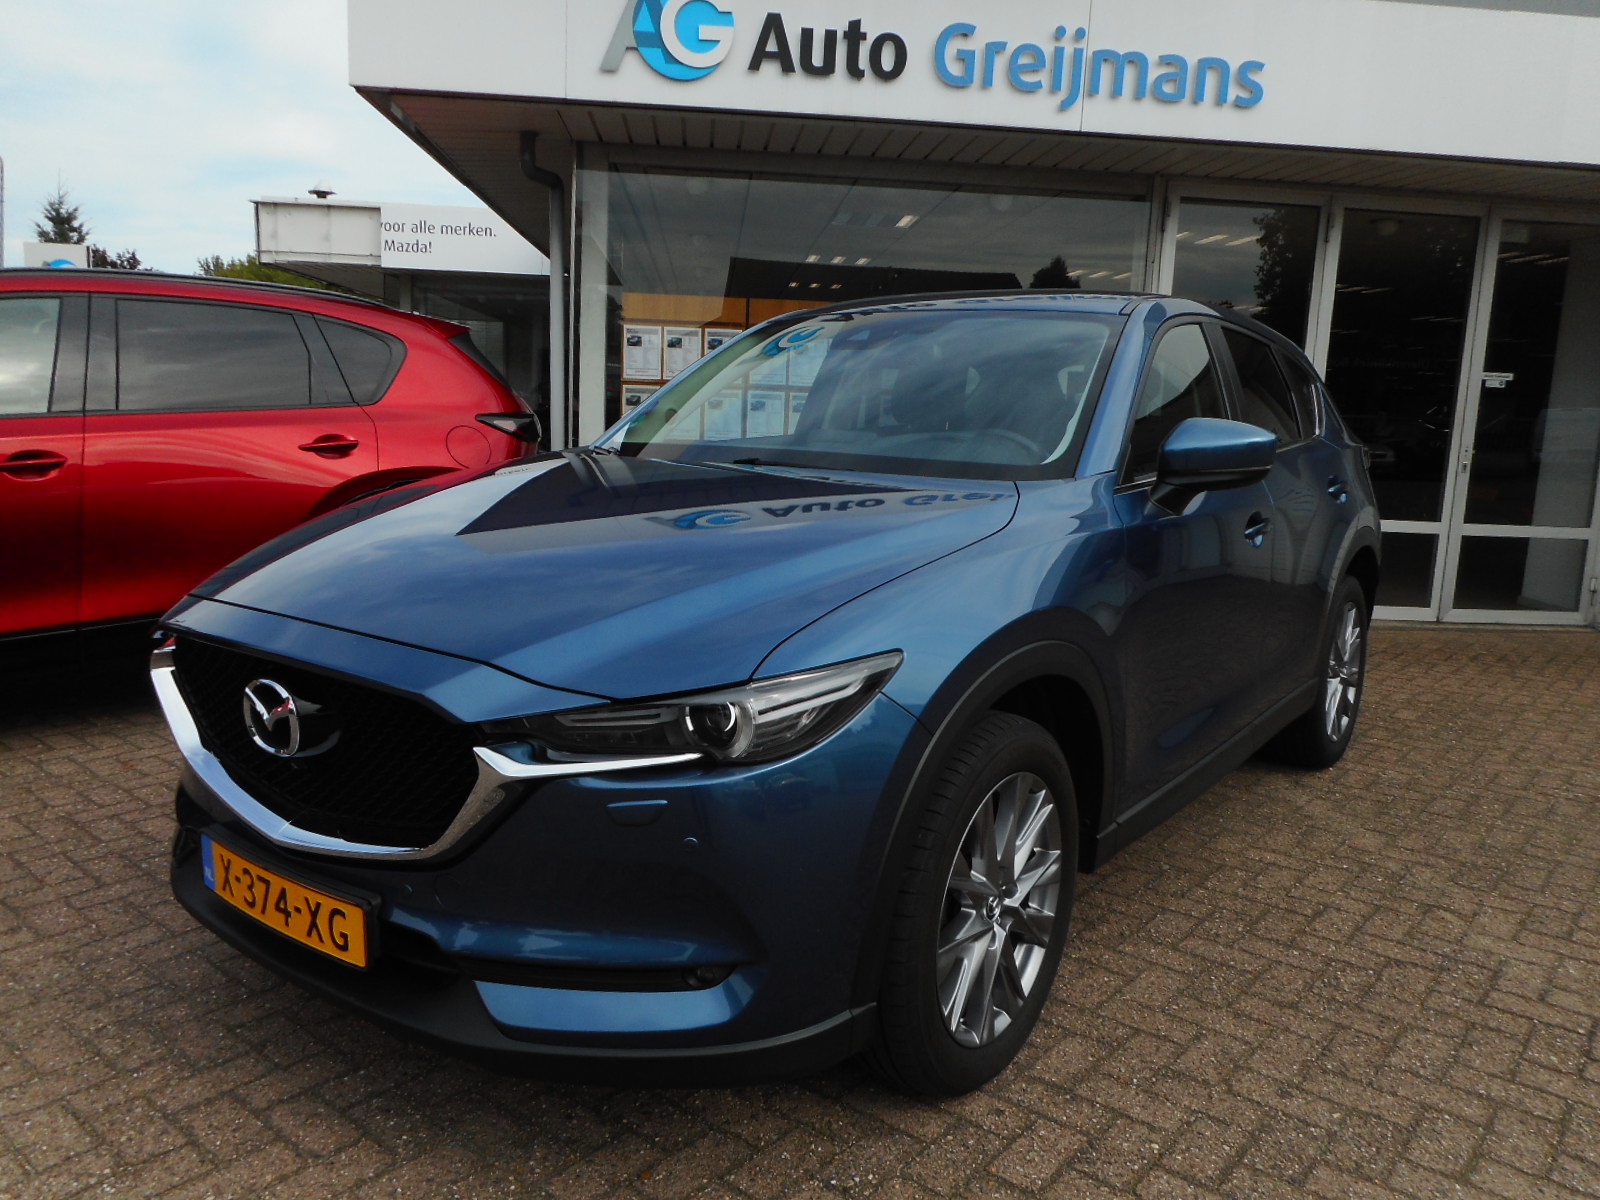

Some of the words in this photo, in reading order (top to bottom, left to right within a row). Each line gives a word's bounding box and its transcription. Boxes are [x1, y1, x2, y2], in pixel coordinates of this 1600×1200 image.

[748, 12, 907, 81] Auto
[934, 22, 1265, 110] Greijmans
[384, 239, 432, 254] Mazda!
[411, 220, 436, 234] alle
[440, 222, 497, 238] merken.
[219, 853, 349, 952] X-374-XG
